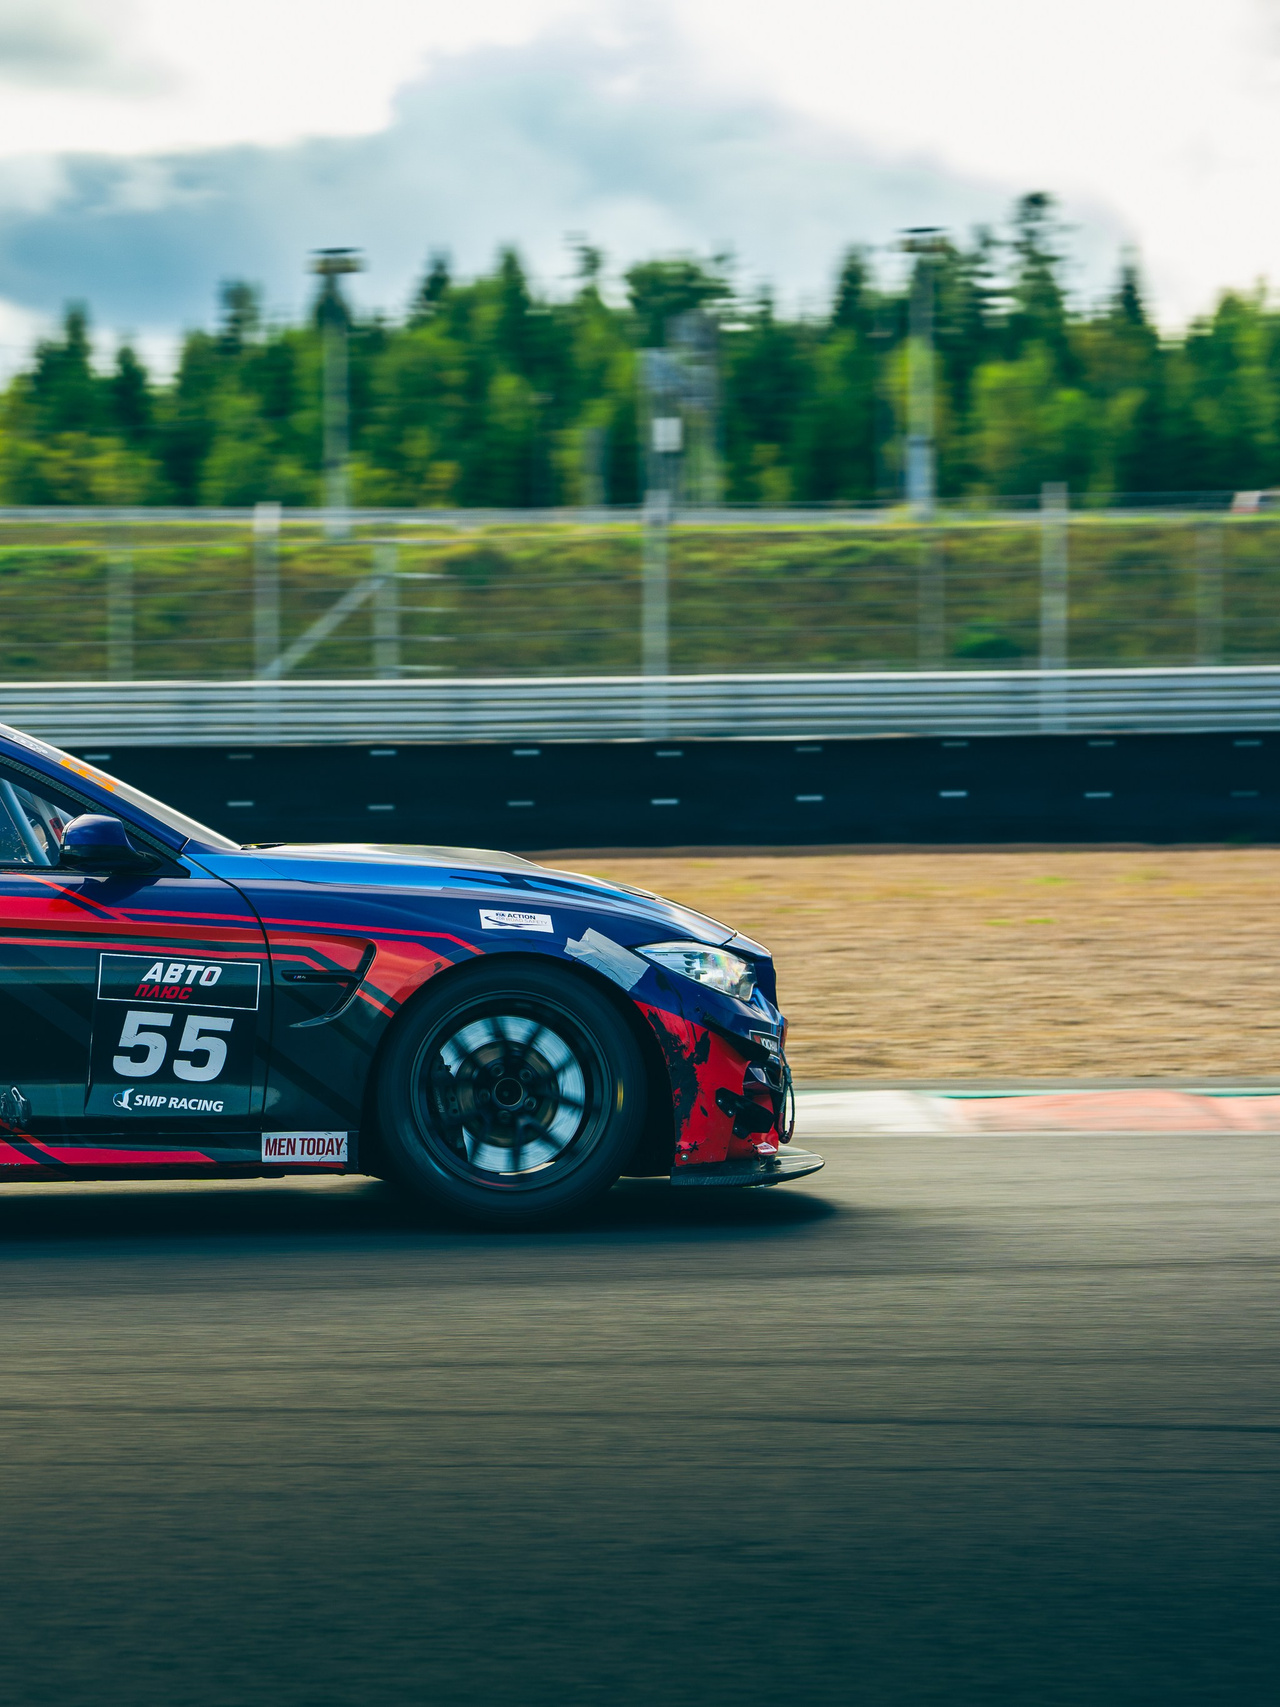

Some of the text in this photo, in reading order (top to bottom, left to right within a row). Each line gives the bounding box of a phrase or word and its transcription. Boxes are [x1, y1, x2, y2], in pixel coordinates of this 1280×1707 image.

[141, 962, 222, 987] АВТО
[134, 984, 193, 1000] ПЛЮС
[112, 1010, 234, 1082] 55
[133, 1094, 224, 1113] SMP RACING
[265, 1138, 345, 1156] MEN TODAY
